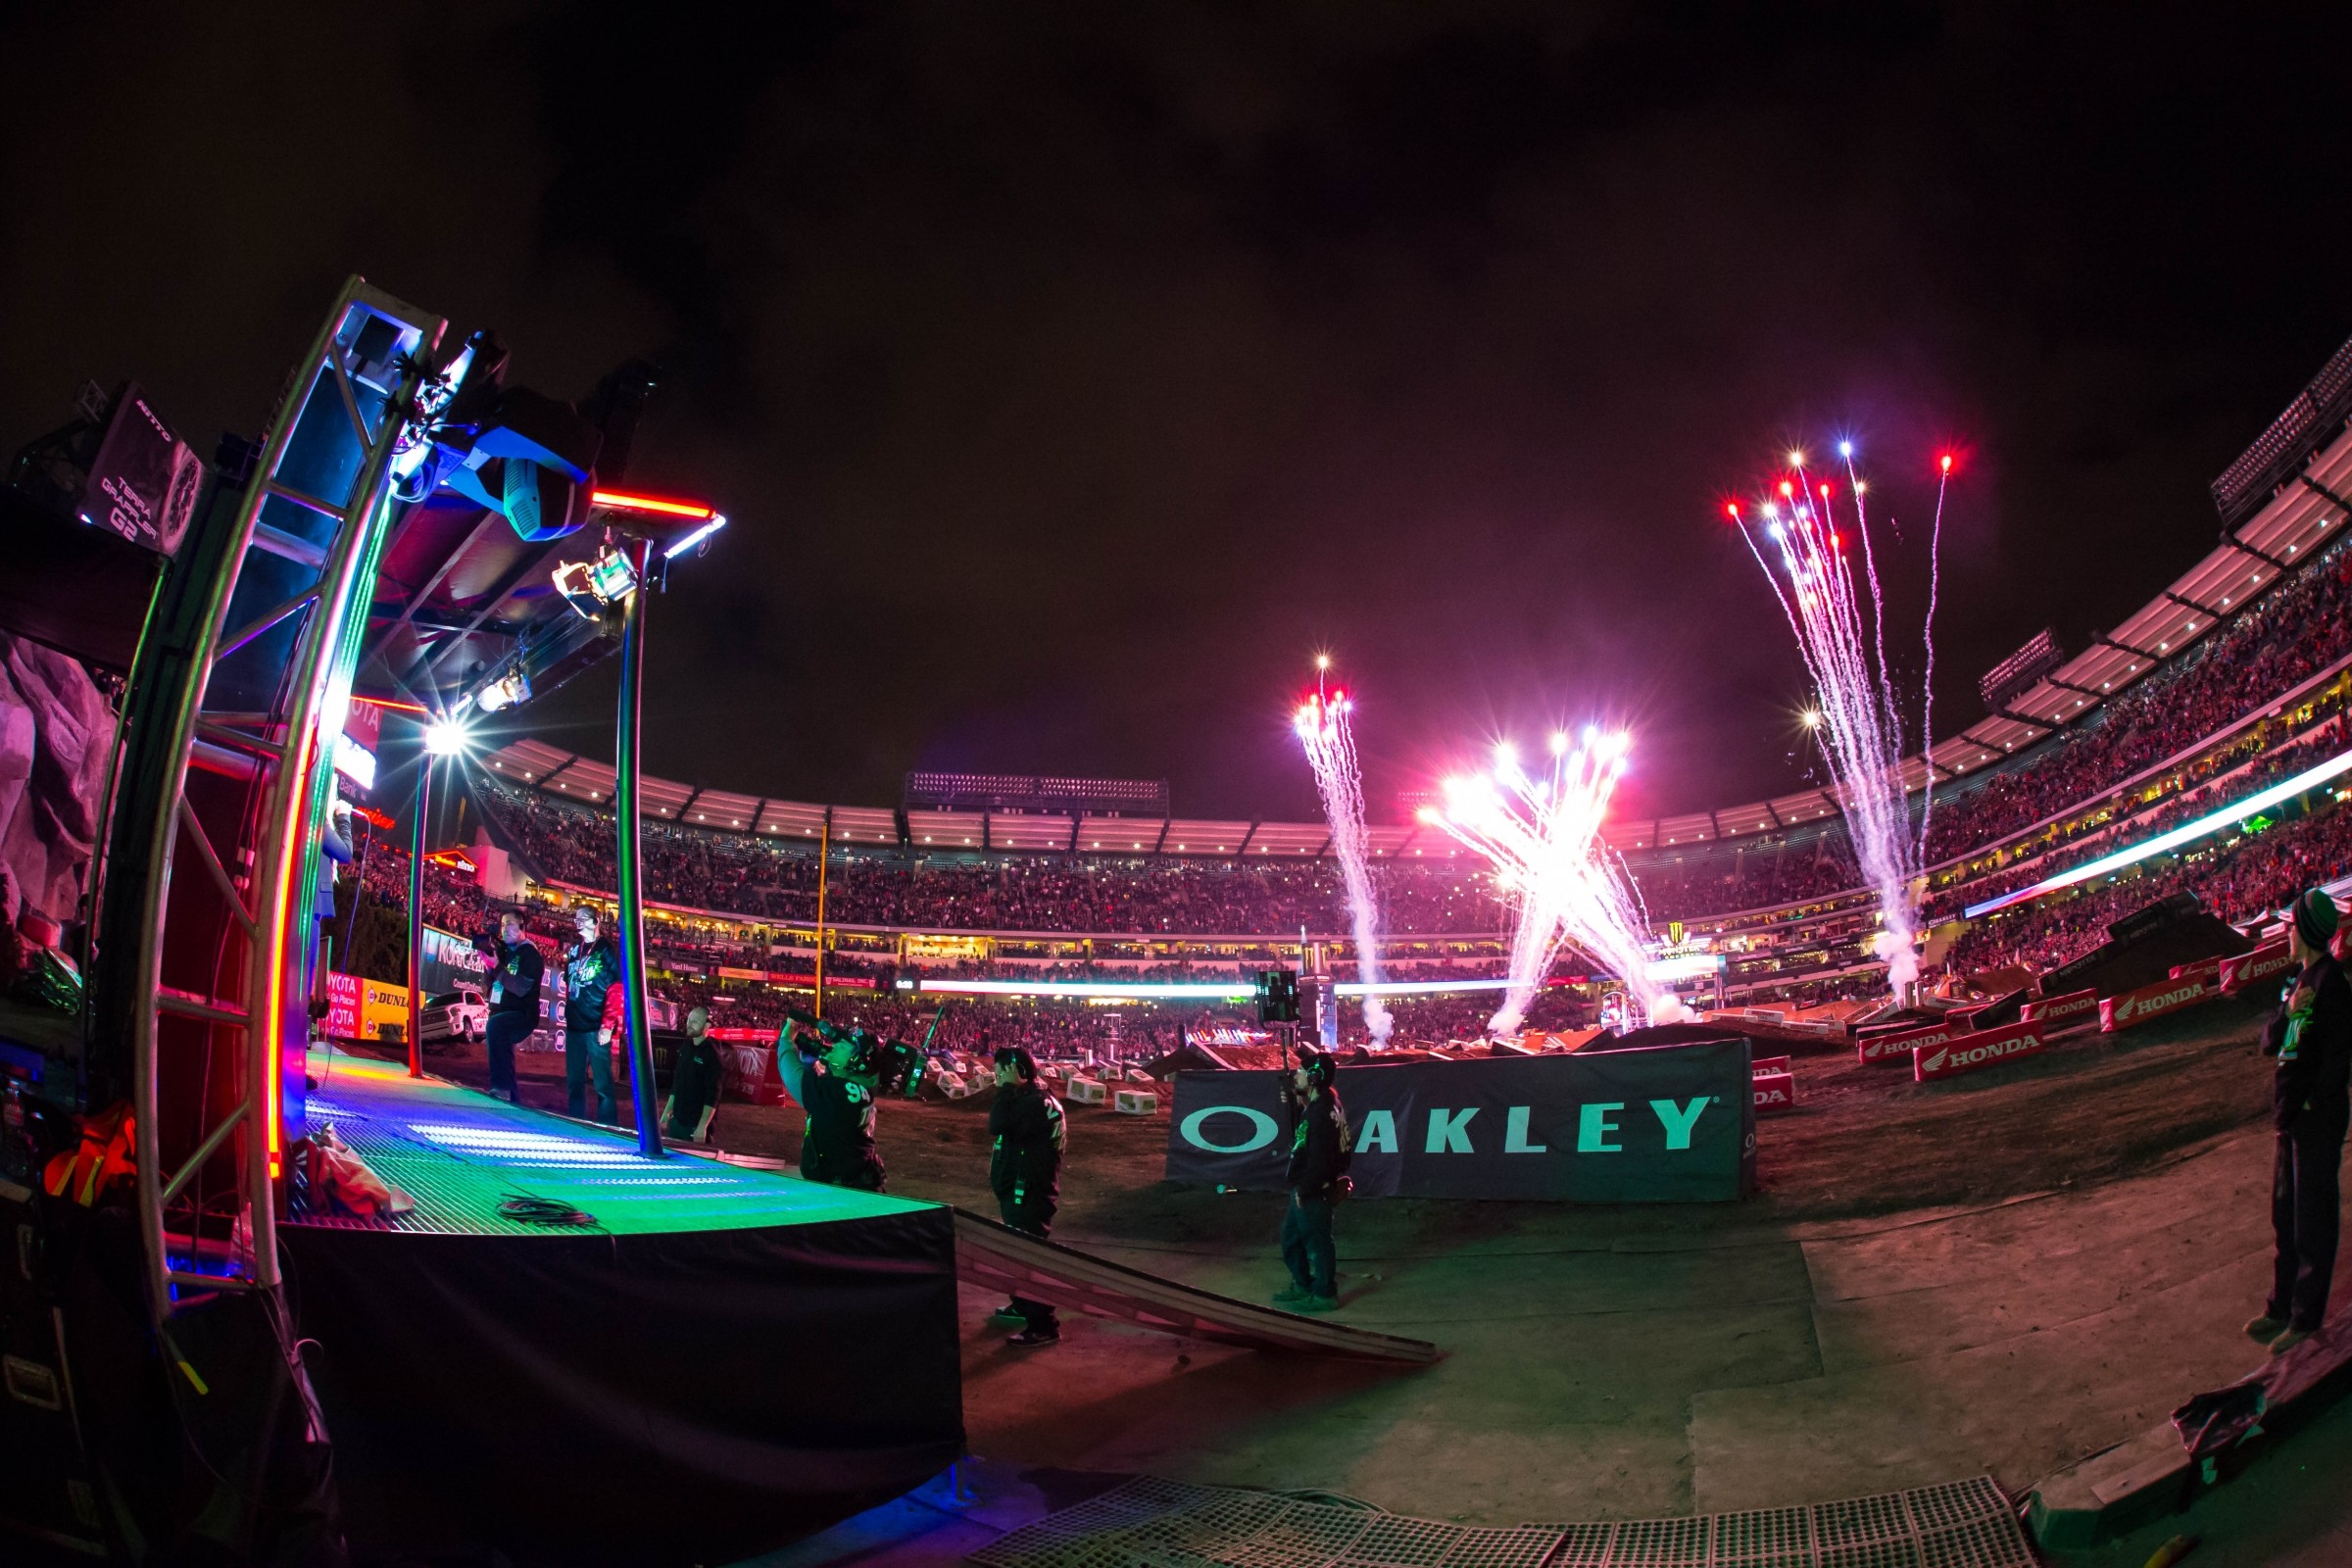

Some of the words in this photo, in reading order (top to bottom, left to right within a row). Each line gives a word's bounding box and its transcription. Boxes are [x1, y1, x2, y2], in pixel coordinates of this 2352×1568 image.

[135, 399, 172, 442] NITTO
[101, 477, 157, 540] GRAPPLER
[119, 476, 151, 519] TERRA
[110, 507, 138, 542] G2
[351, 702, 379, 732] OTA
[339, 776, 357, 799] Bank
[683, 962, 699, 972] House
[328, 974, 356, 994] YOTA
[377, 992, 410, 1008] DUNL
[2049, 997, 2097, 1018] HONDA
[2136, 983, 2205, 1015] HONDA
[327, 1008, 355, 1026] YOTA
[376, 1023, 409, 1037] DUNL
[1884, 1032, 1950, 1054] HONDA
[1949, 1034, 2040, 1067] HONDA
